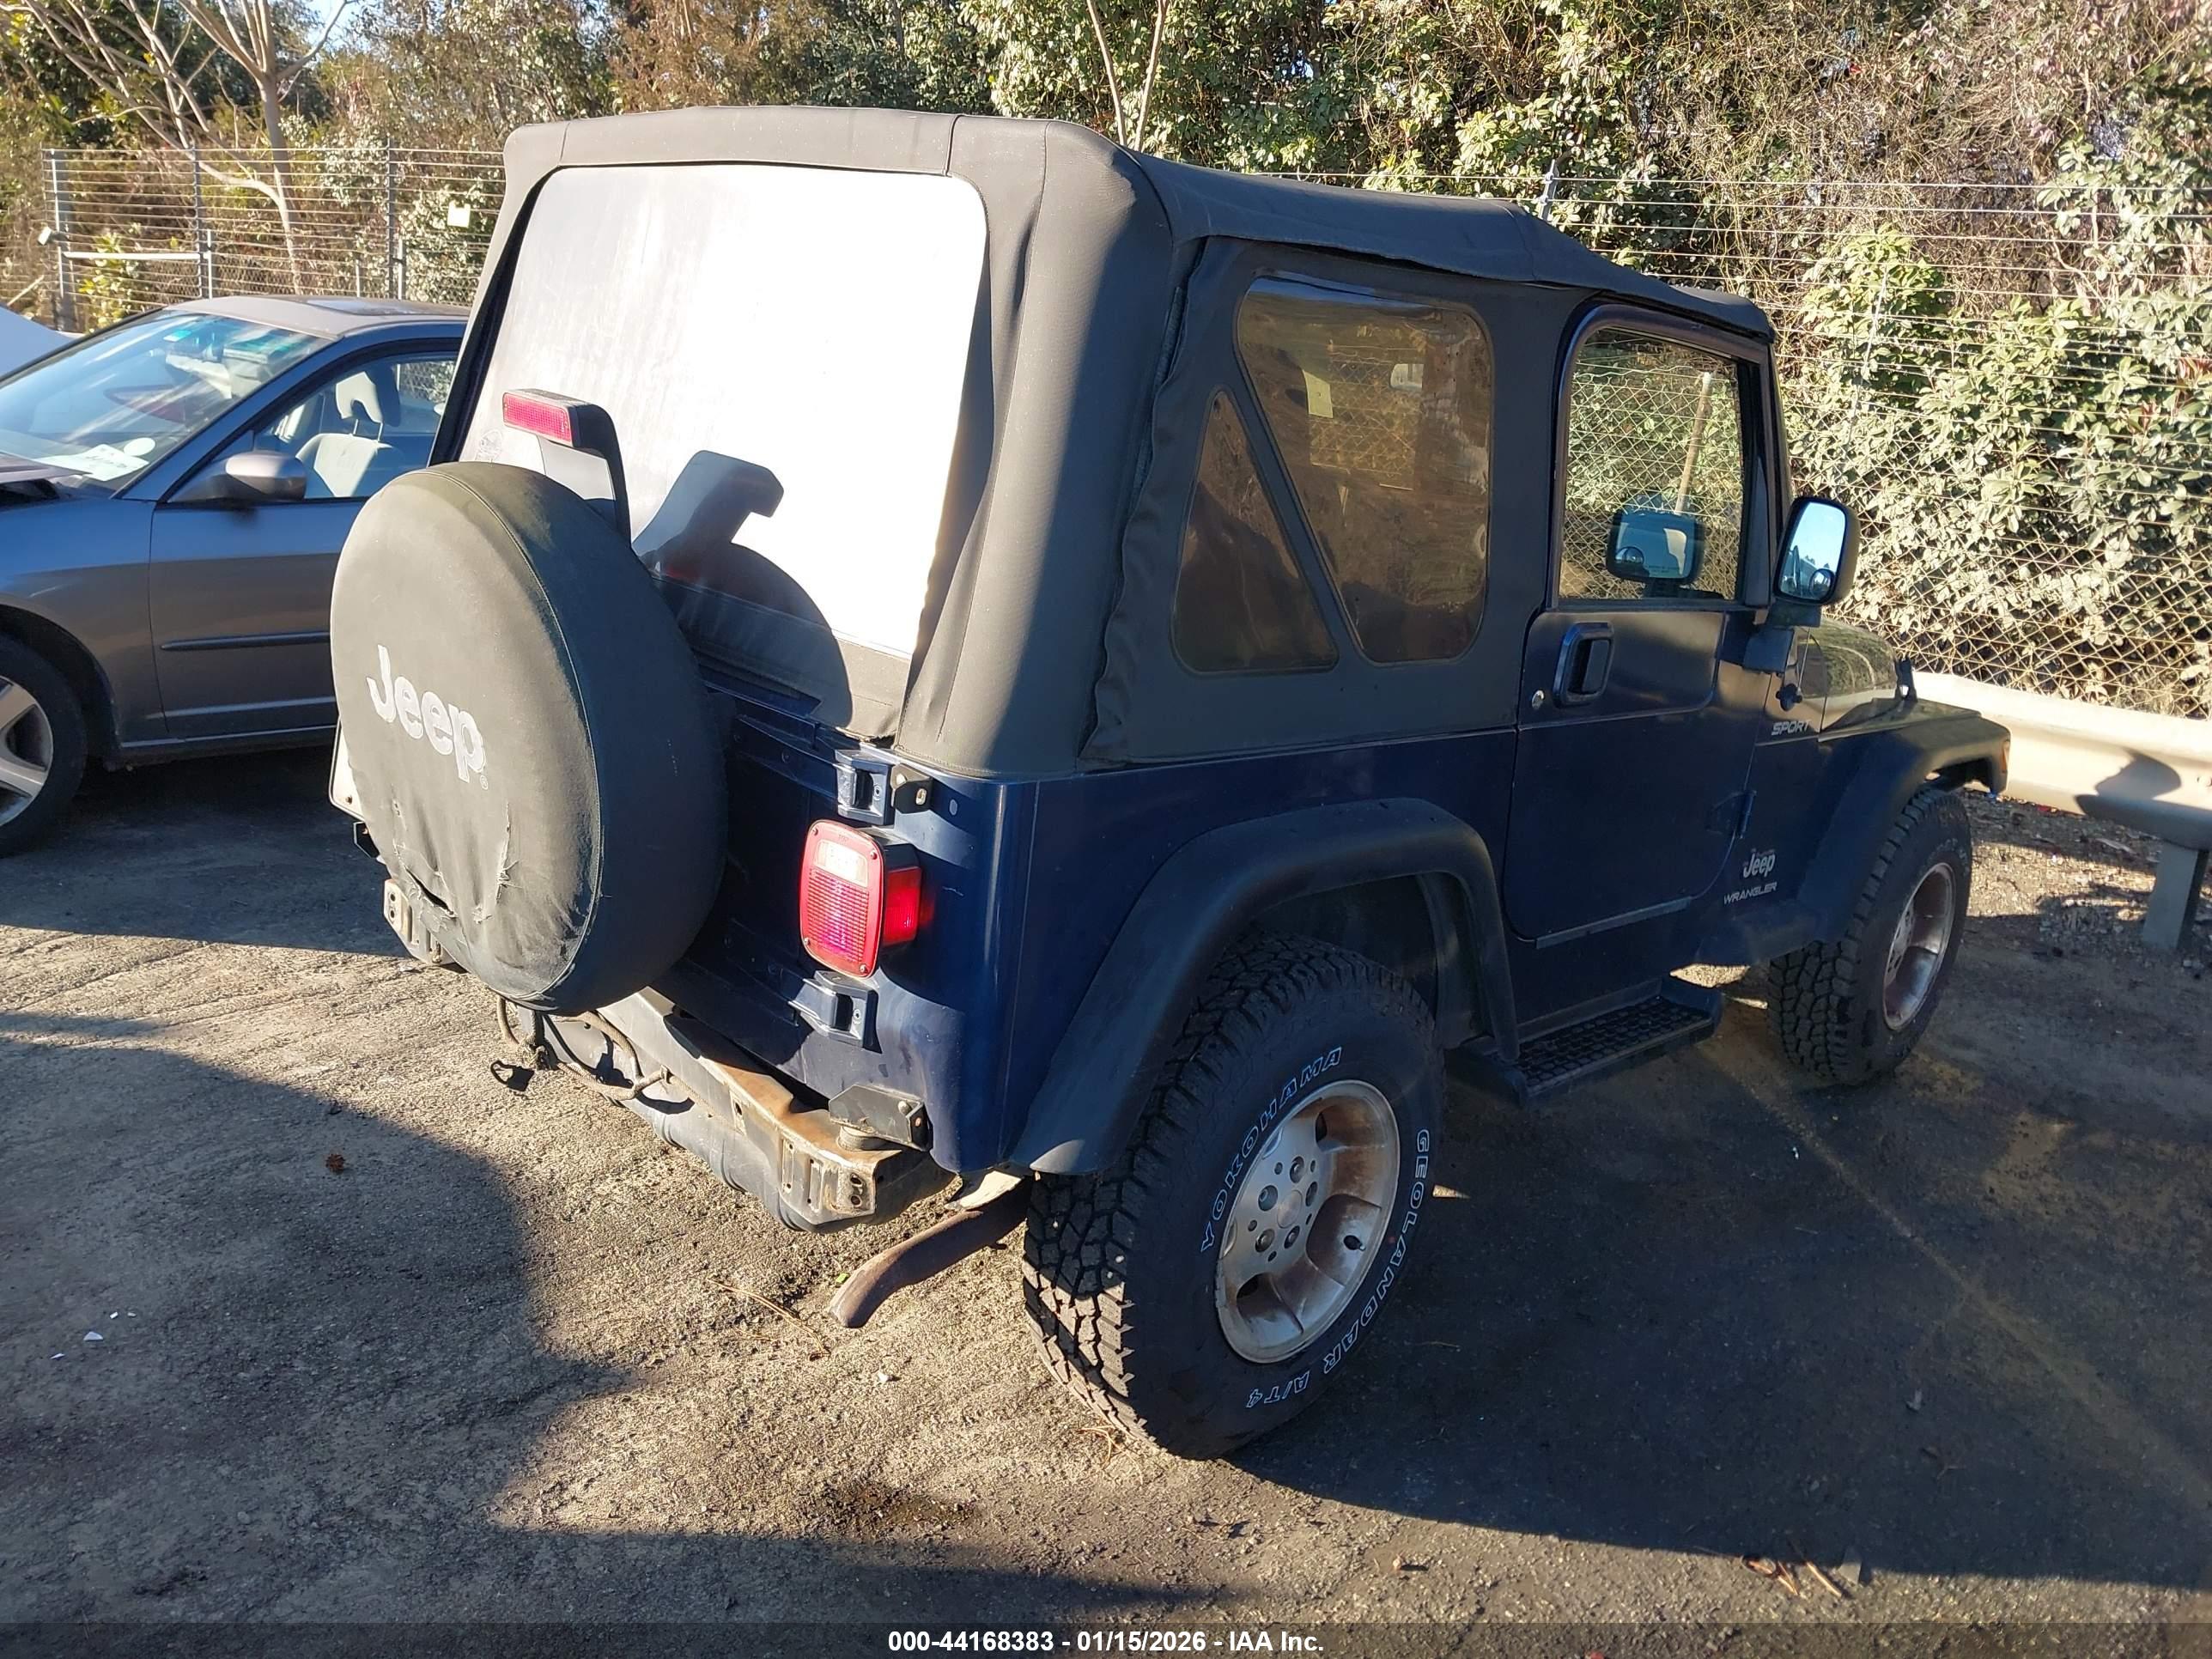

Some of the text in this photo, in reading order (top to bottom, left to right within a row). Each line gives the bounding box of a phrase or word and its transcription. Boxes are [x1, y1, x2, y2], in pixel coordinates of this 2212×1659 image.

[1771, 720, 1811, 736] SPORT
[1742, 853, 1776, 878] Jeep
[1723, 881, 1778, 905] WRANGLER
[1200, 1046, 1343, 1253] YOKOHAMA
[1246, 1128, 1430, 1408] GEOLANDAR A/T4
